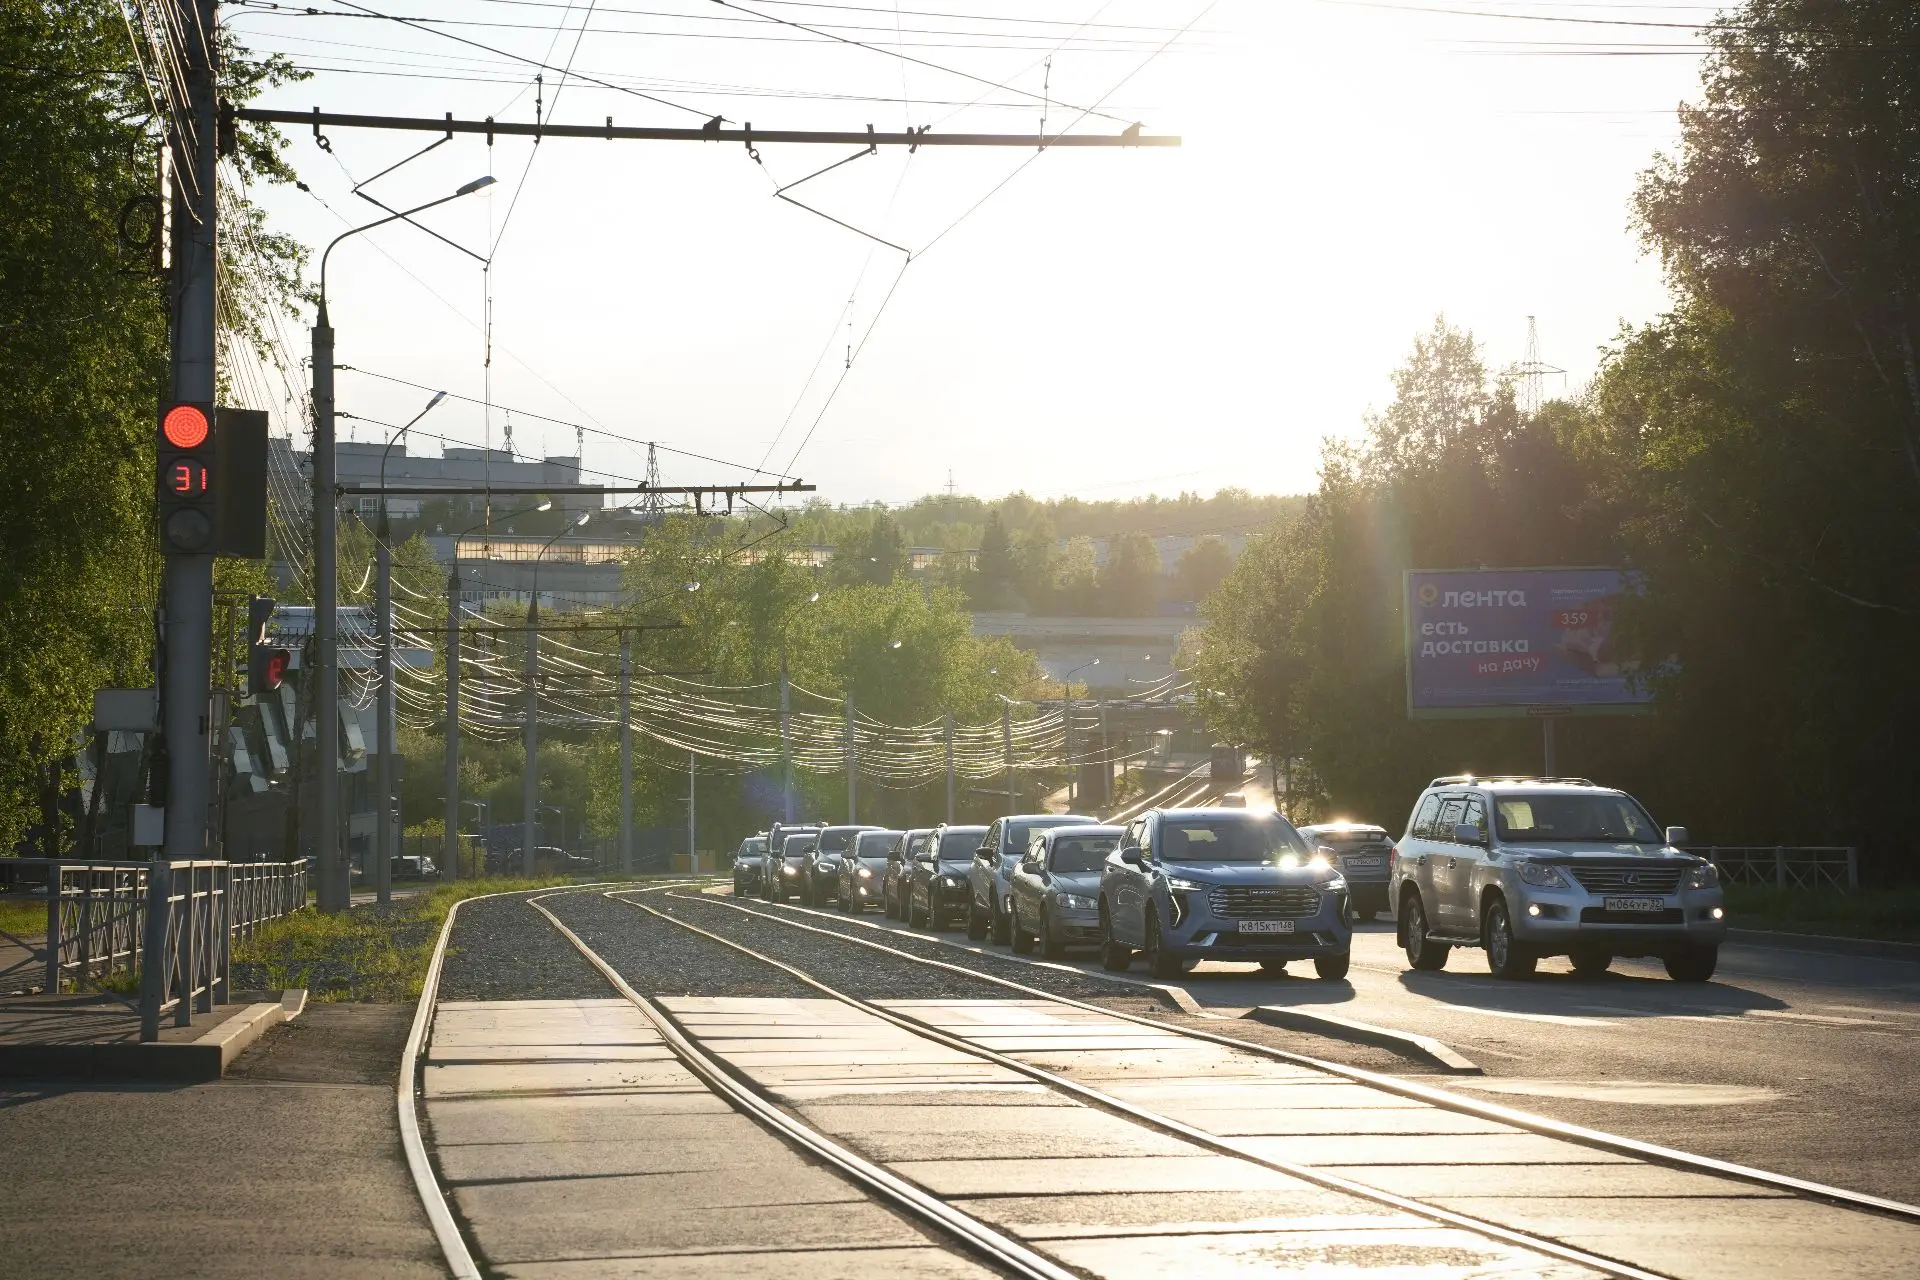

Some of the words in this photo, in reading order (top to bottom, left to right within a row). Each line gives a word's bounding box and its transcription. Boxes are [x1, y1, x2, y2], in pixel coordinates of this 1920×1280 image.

[175, 465, 208, 492] 31
[1442, 589, 1527, 608] лента
[1560, 612, 1588, 625] 359
[1421, 620, 1469, 636] есть
[1421, 639, 1529, 658] доставка
[1478, 662, 1500, 673] на
[1502, 657, 1540, 672] дачу
